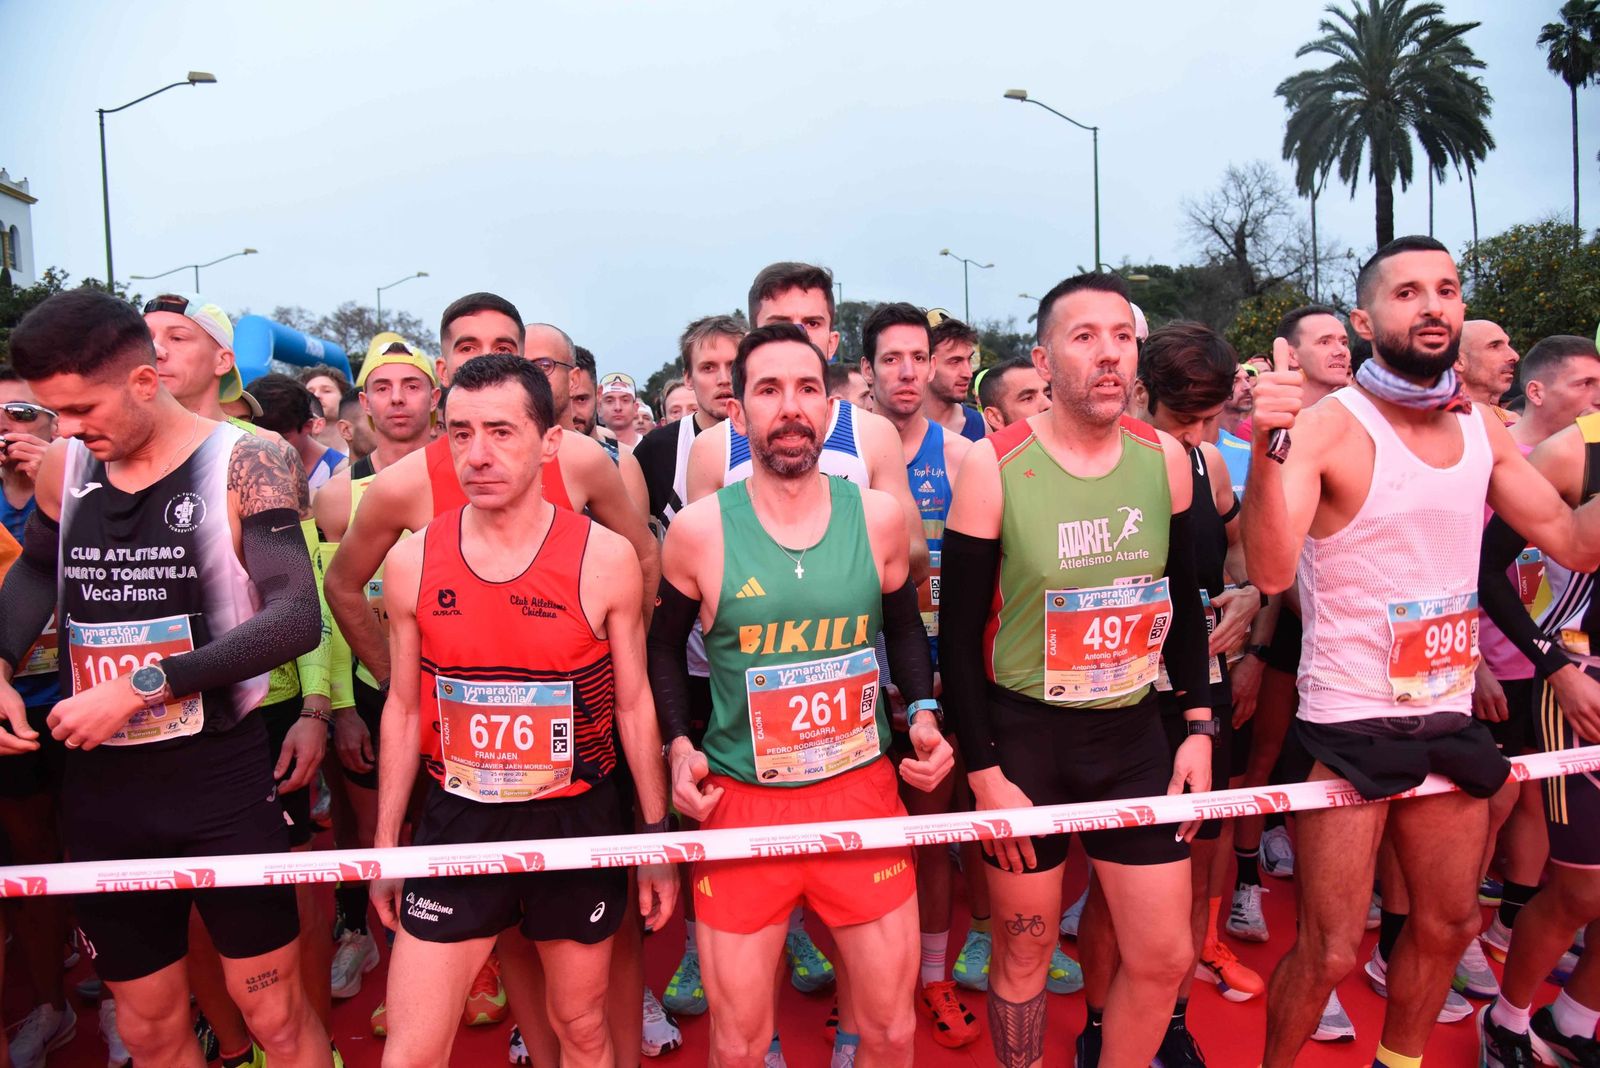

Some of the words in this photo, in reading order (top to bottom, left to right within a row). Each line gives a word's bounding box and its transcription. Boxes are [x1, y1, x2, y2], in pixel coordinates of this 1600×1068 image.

[914, 468, 926, 478] Top
[931, 468, 944, 478] Life
[1058, 518, 1112, 559] ATARFE
[71, 547, 100, 560] CLUB
[104, 546, 186, 562] ATLETISMO
[1060, 554, 1112, 570] Atletismo
[1116, 548, 1150, 562] Atarfe
[110, 566, 198, 581] TORREVIEJA
[1092, 588, 1136, 599] maratón
[1102, 596, 1136, 606] sevilla
[90, 625, 138, 637] maratón
[1082, 614, 1142, 650] 497
[102, 634, 140, 646] sevilla
[1424, 619, 1467, 658] 998
[1084, 652, 1111, 660] Antonio
[794, 661, 840, 675] maratón
[805, 668, 840, 683] sevilla
[476, 686, 526, 696] maratón
[487, 694, 526, 704] sevilla
[788, 687, 847, 732] 261
[469, 713, 535, 751] 676
[800, 726, 836, 740] BOGARRA
[766, 746, 792, 754] PEDRO
[793, 738, 834, 751] RODRIGUEZ
[450, 754, 480, 768] FRANCISCO
[474, 750, 496, 760] FRAN
[497, 752, 518, 760] JAEN
[804, 766, 824, 775] HOKA
[415, 897, 454, 914] Atletismo
